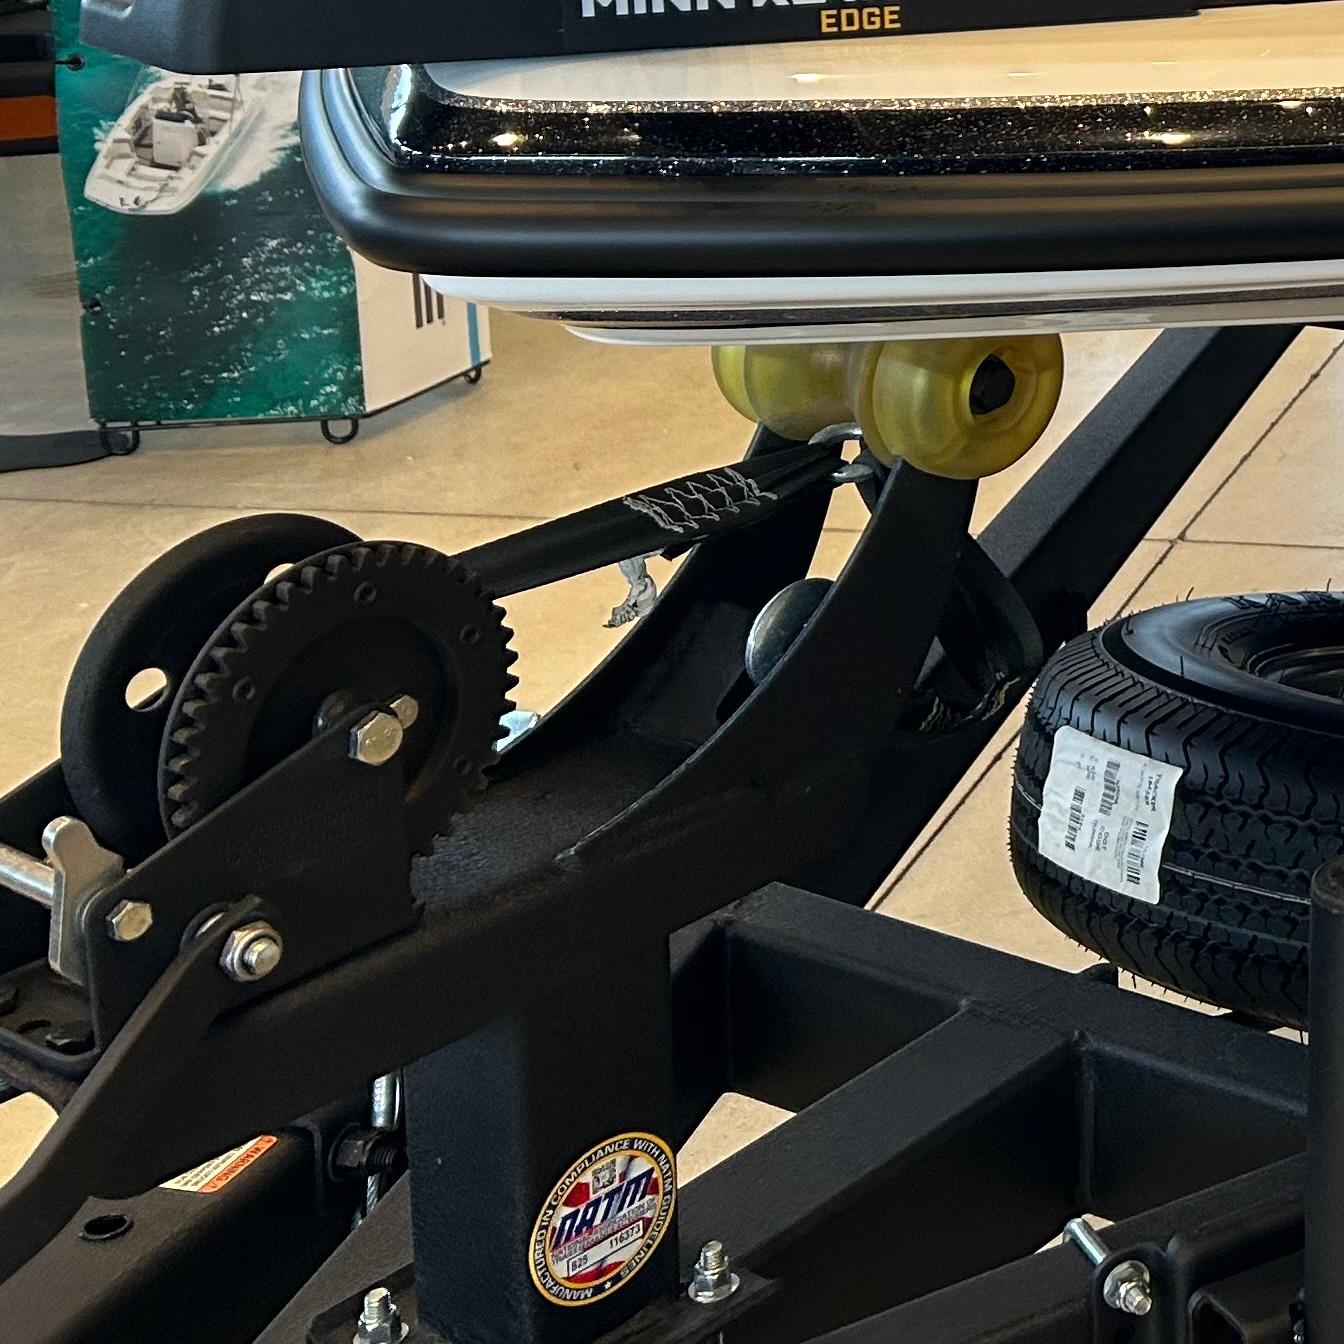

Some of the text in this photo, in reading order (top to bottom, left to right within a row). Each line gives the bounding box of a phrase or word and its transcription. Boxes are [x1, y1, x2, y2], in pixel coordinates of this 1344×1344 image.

[820, 6, 902, 33] EDGE
[551, 1139, 631, 1206] COMPLIANCE
[633, 1138, 659, 1157] WITH
